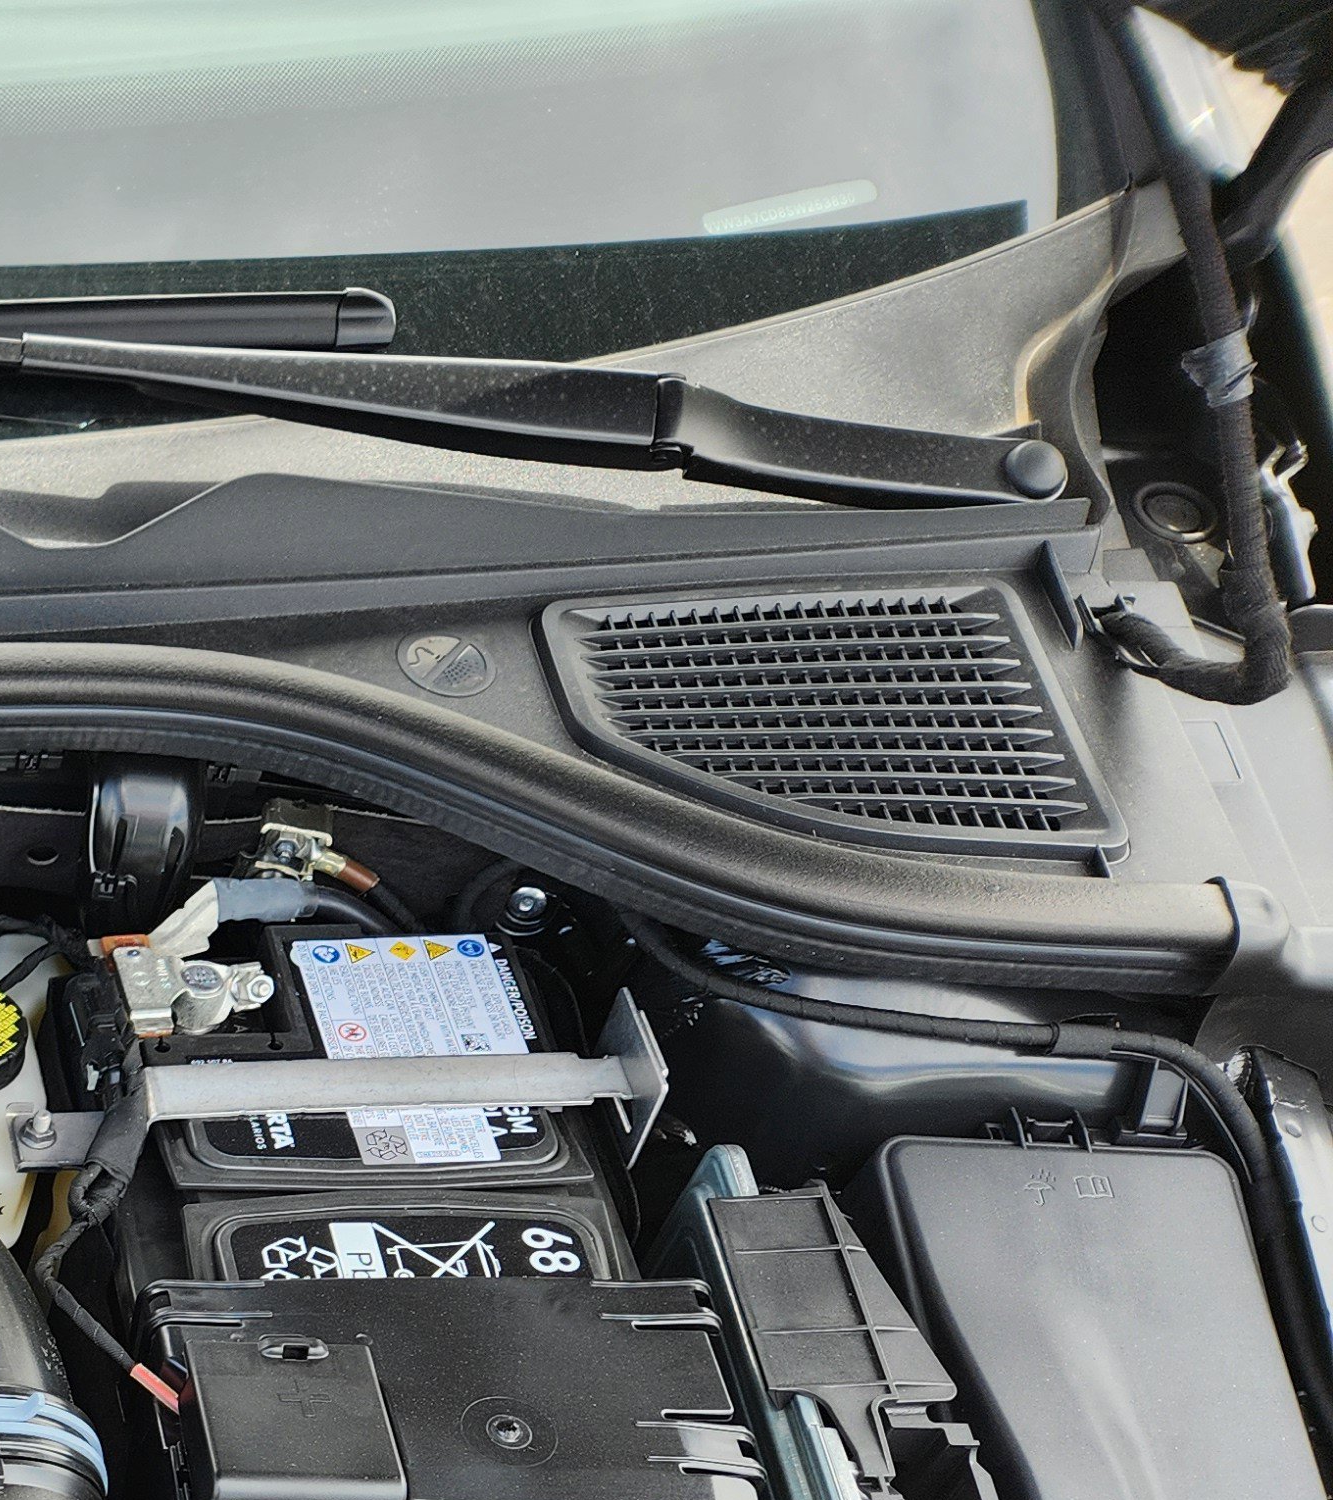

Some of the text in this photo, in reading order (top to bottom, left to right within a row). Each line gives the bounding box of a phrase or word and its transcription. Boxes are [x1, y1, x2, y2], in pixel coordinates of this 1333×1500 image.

[494, 957, 538, 1041] DANGER/POISON
[249, 1116, 267, 1151] LARIOS
[265, 1112, 296, 1151] RTA
[504, 1106, 538, 1134] GM
[346, 1252, 374, 1278] Pb
[522, 1228, 581, 1273] 68
